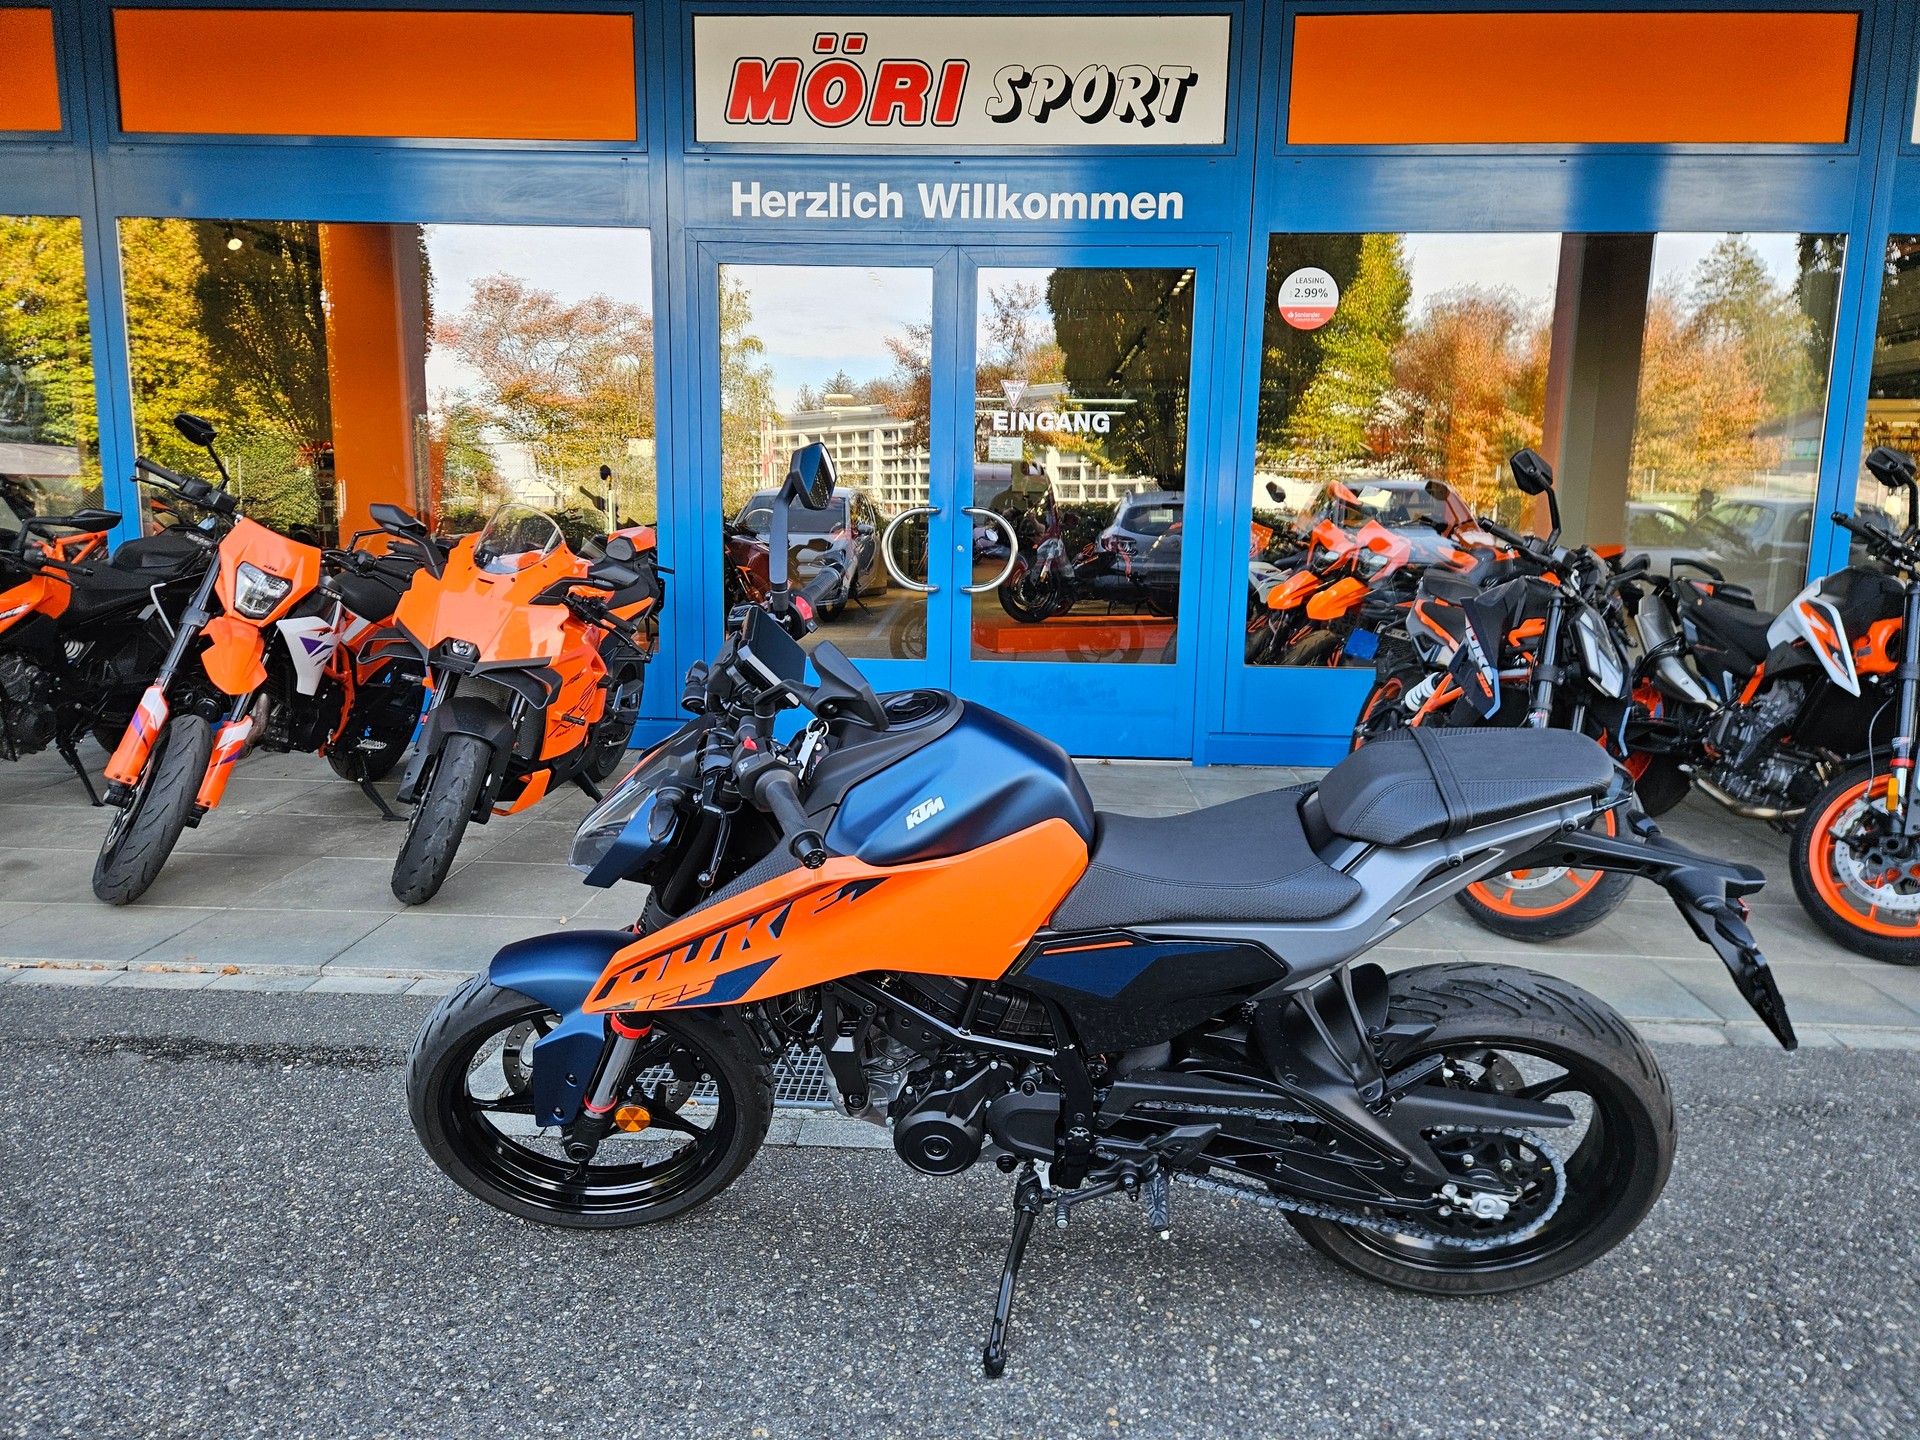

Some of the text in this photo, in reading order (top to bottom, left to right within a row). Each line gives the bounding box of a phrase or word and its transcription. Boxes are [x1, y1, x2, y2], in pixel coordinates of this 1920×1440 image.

[724, 32, 1198, 128] MÖRI SPORT
[731, 181, 1184, 220] Herzlich Willkommen
[1294, 288, 1329, 298] 2.99%
[993, 412, 1111, 433] EINGANG
[906, 797, 946, 830] KTM
